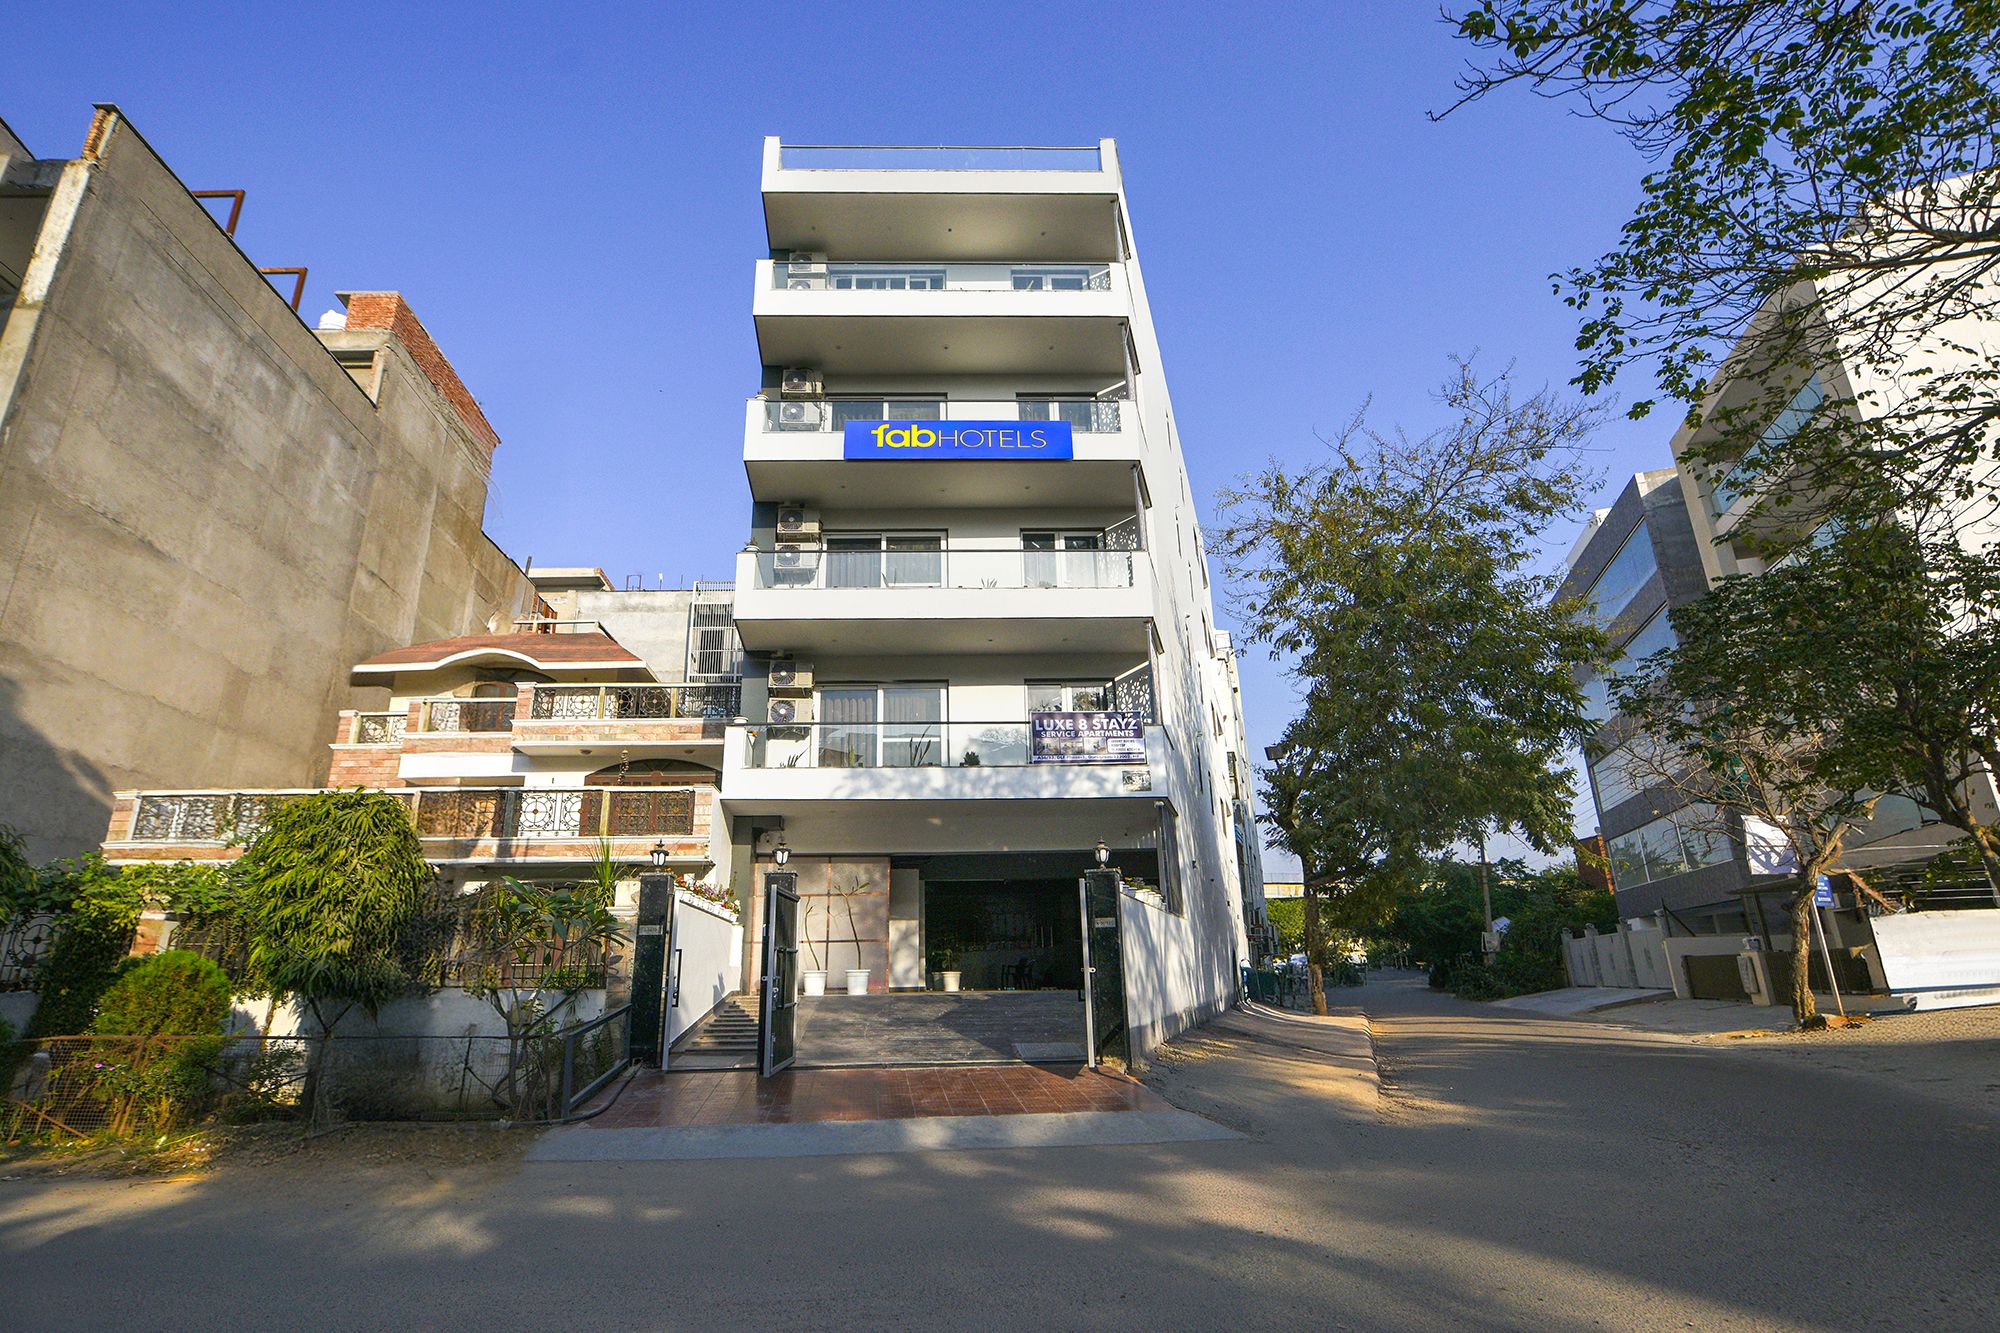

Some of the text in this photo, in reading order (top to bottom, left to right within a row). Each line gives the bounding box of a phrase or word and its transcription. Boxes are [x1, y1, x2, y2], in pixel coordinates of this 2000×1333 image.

[871, 423, 1047, 448] fabHOTELS
[1035, 719, 1074, 731] LUXE
[1092, 718, 1138, 730] STAYZ
[1041, 730, 1076, 738] SERVICE
